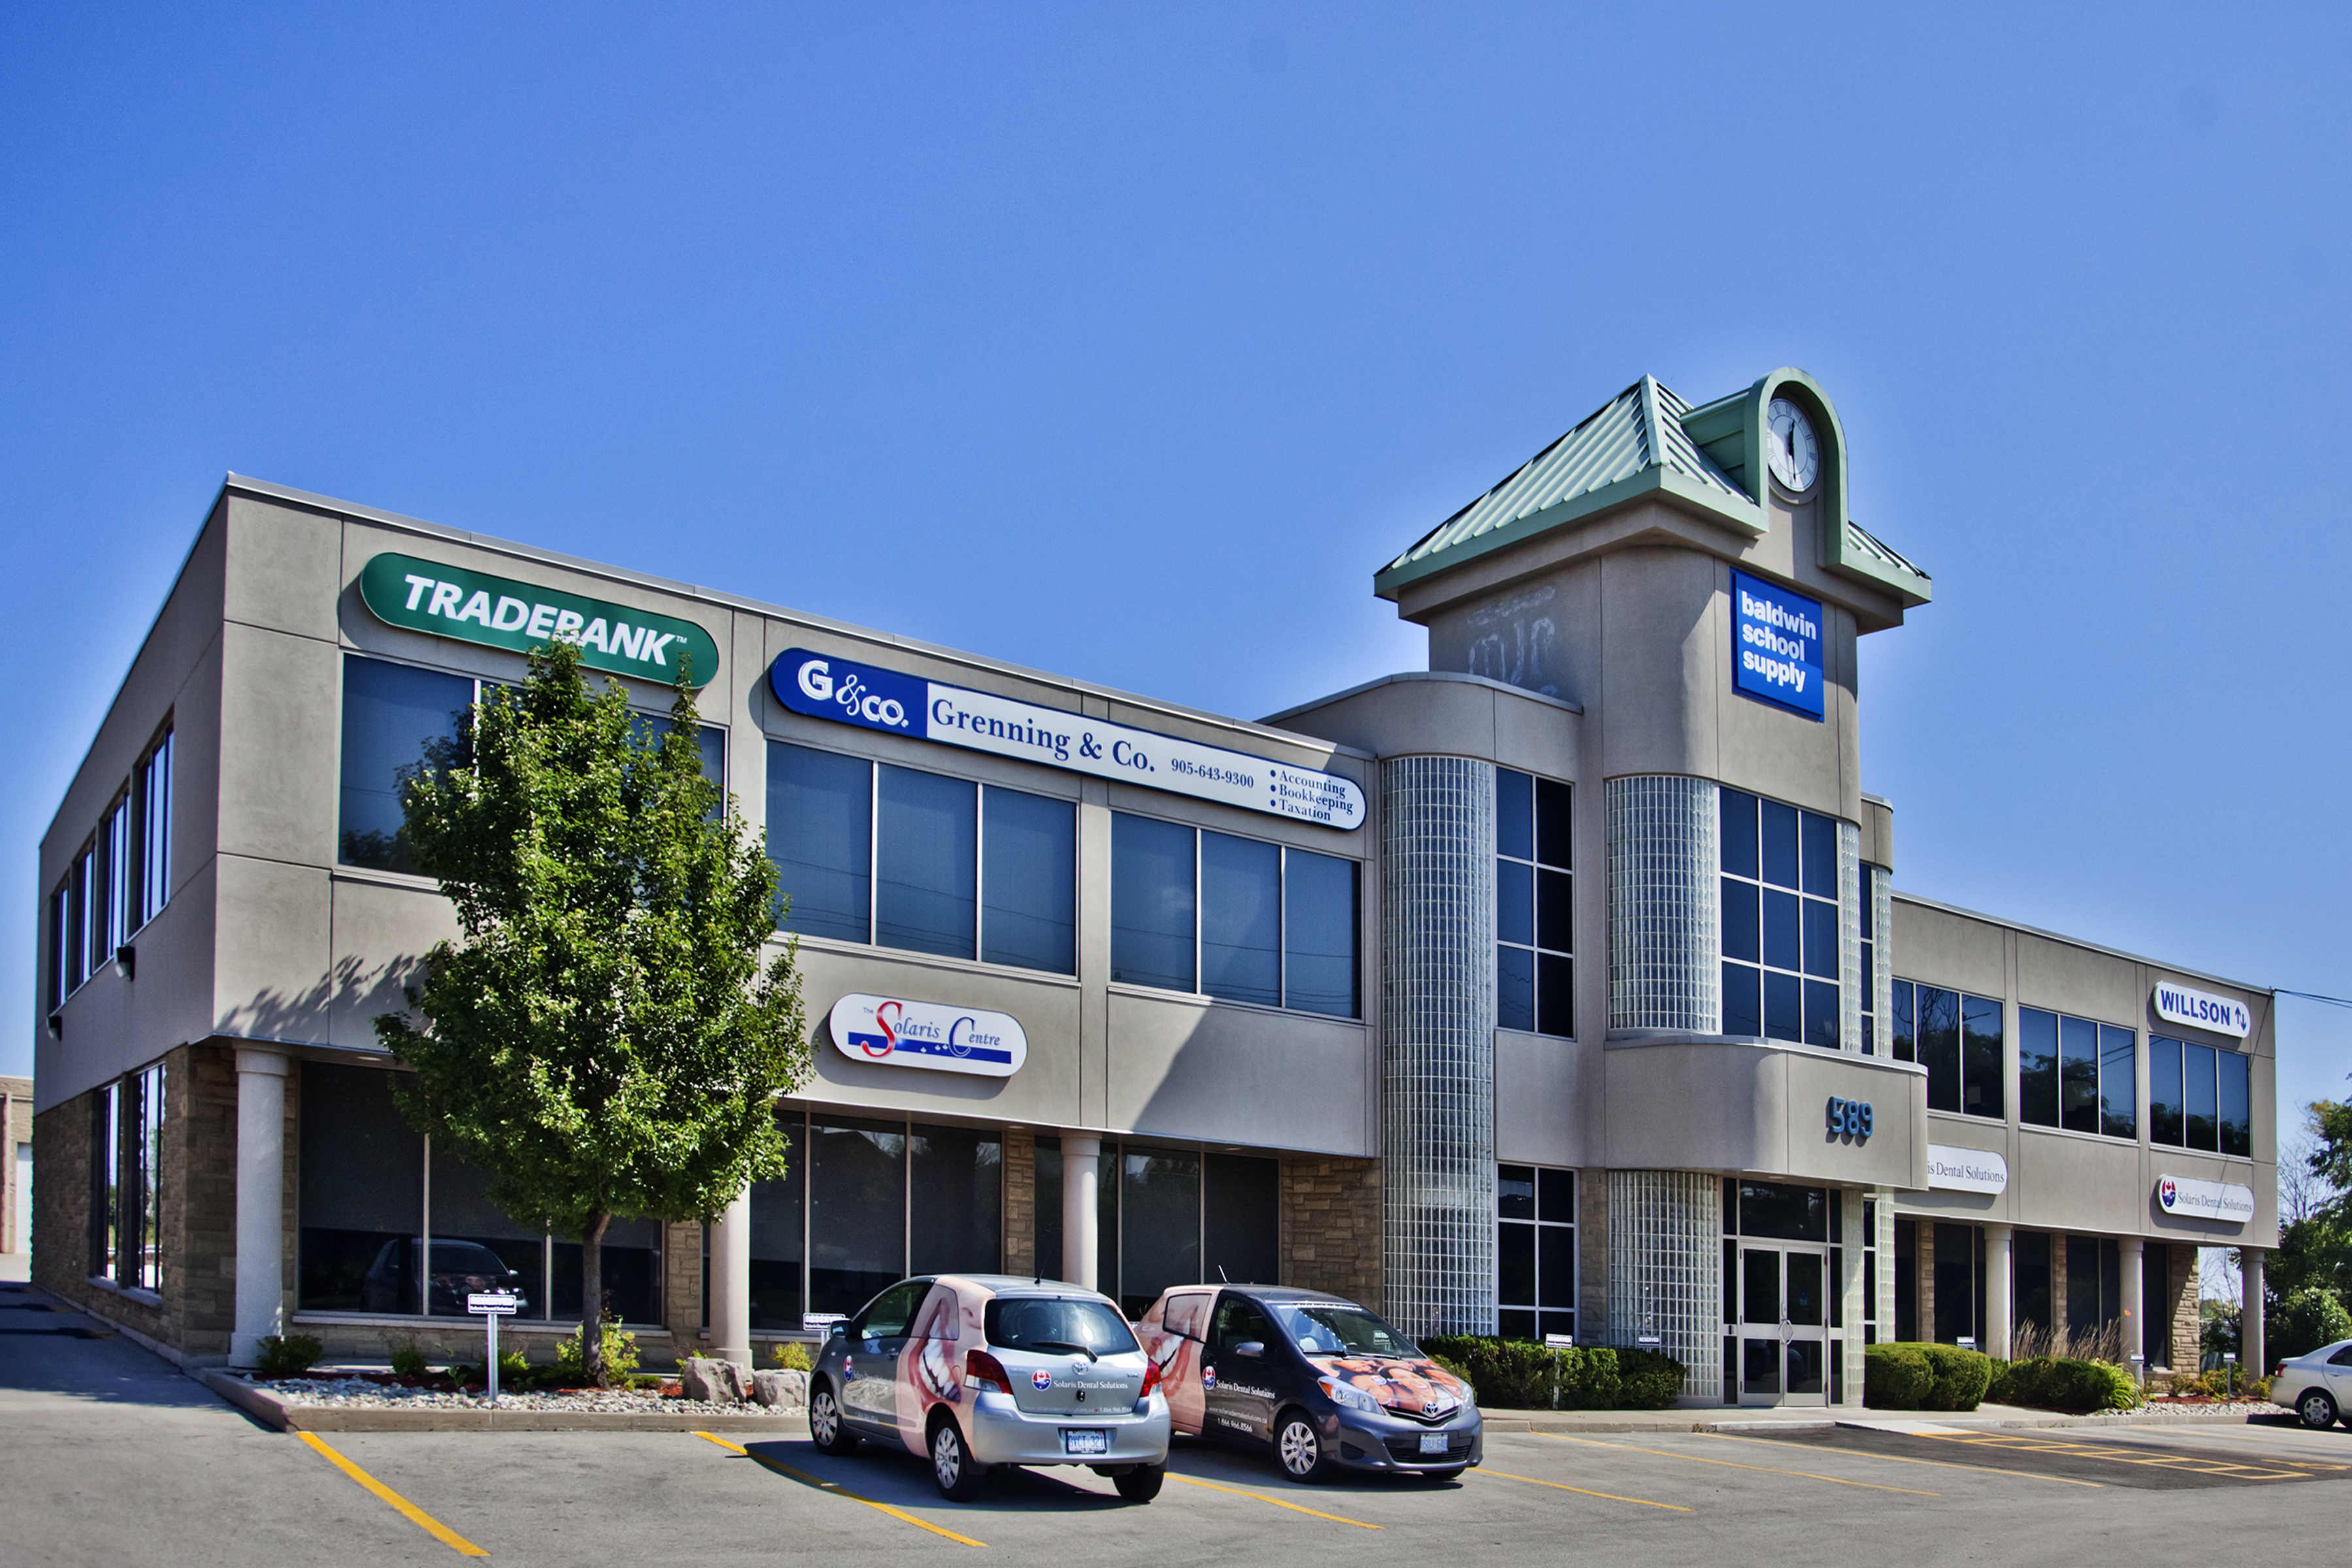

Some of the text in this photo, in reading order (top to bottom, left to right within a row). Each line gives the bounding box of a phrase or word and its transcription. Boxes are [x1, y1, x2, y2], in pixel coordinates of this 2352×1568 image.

[1741, 590, 1817, 640] baldwin
[1742, 623, 1805, 662] school
[1742, 650, 1806, 693] supply
[932, 698, 1155, 772] Grenning & Co.
[1171, 758, 1254, 789] 905-643-9300
[1279, 770, 1346, 799] Accounting
[1279, 783, 1354, 815] Bookkeeping
[1279, 798, 1331, 821] Taxation
[2160, 989, 2230, 1026] WILLSON
[860, 1001, 1001, 1058] Solaris Centre
[1829, 1096, 1874, 1138] 589
[1936, 1162, 1965, 1179] Dental
[1965, 1165, 2005, 1183] Solutions
[2178, 1191, 2200, 1206] Solaris
[2223, 1197, 2253, 1213] Solutions
[1053, 1380, 1128, 1389] Solaris Dental Solutions
[1216, 1379, 1275, 1399] Solaris Dental Solutions
